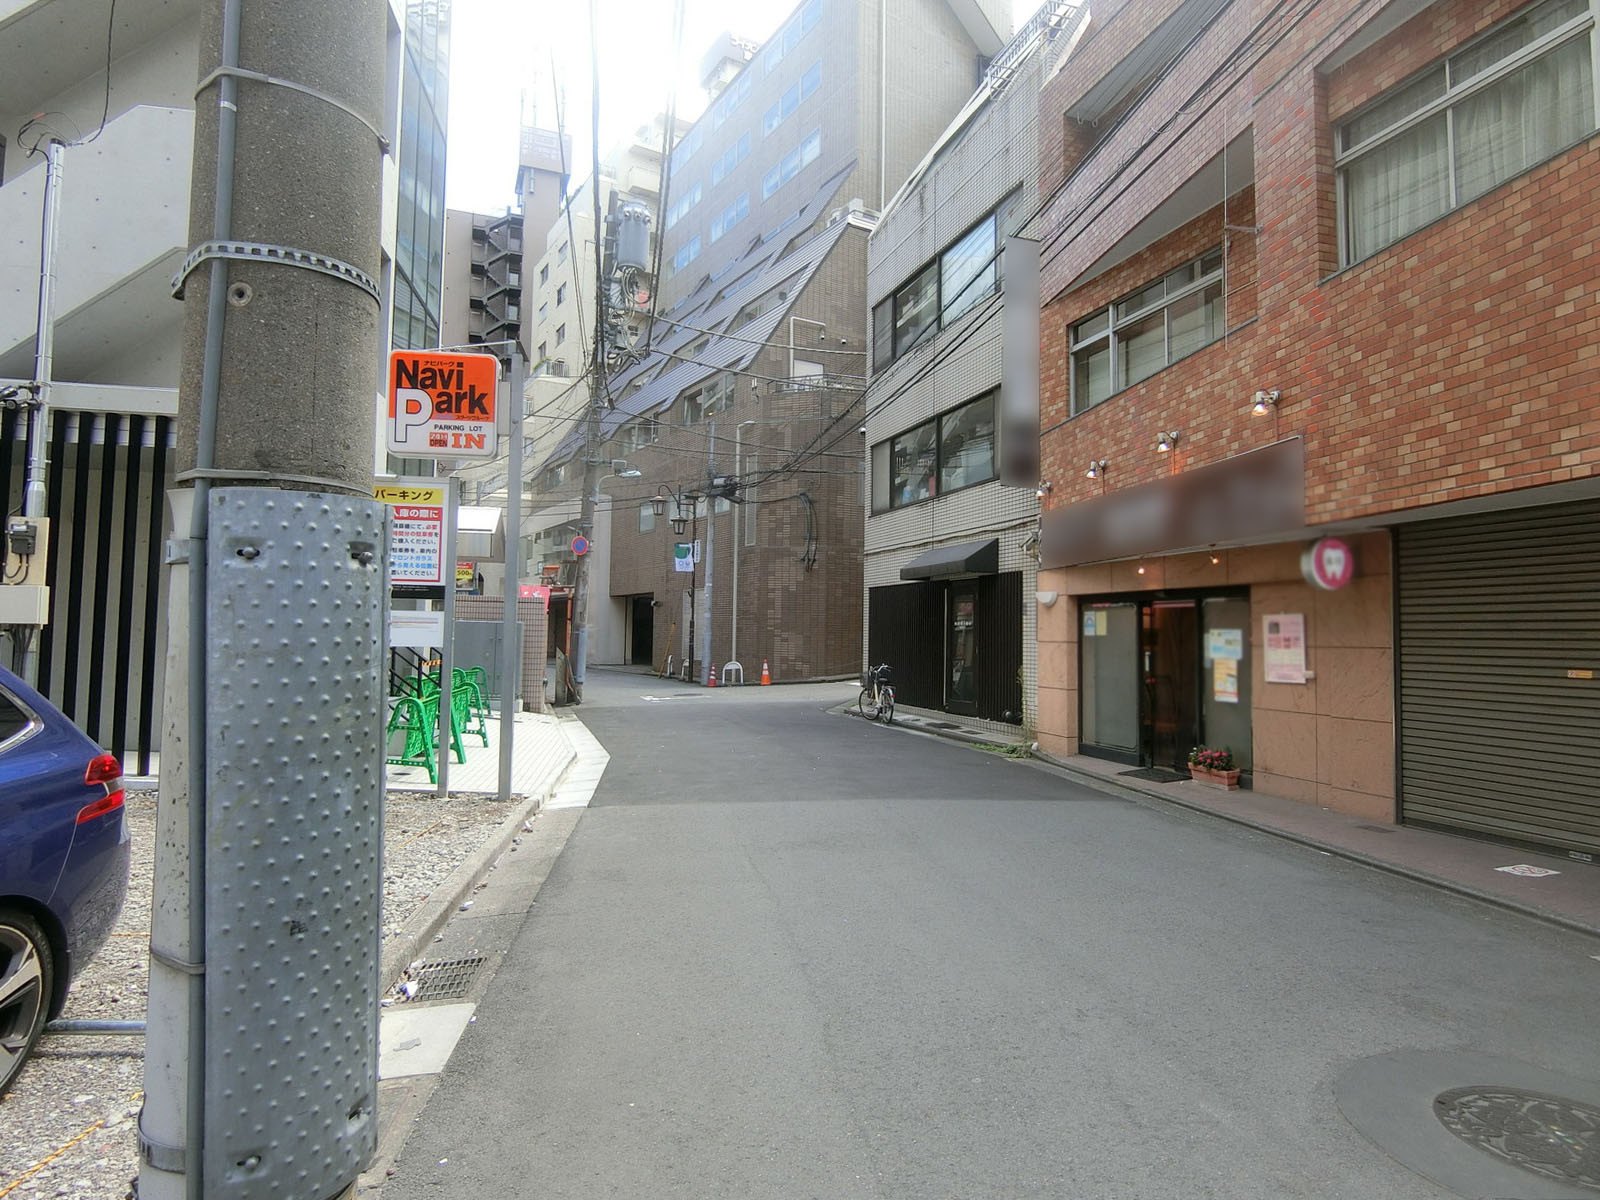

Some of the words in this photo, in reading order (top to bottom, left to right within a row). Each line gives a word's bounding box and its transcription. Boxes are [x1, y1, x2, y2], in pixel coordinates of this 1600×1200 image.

[396, 359, 464, 390] Navi
[394, 384, 489, 443] Park
[430, 439, 448, 447] OPEN
[452, 432, 486, 449] IN
[375, 489, 434, 500] パーキング
